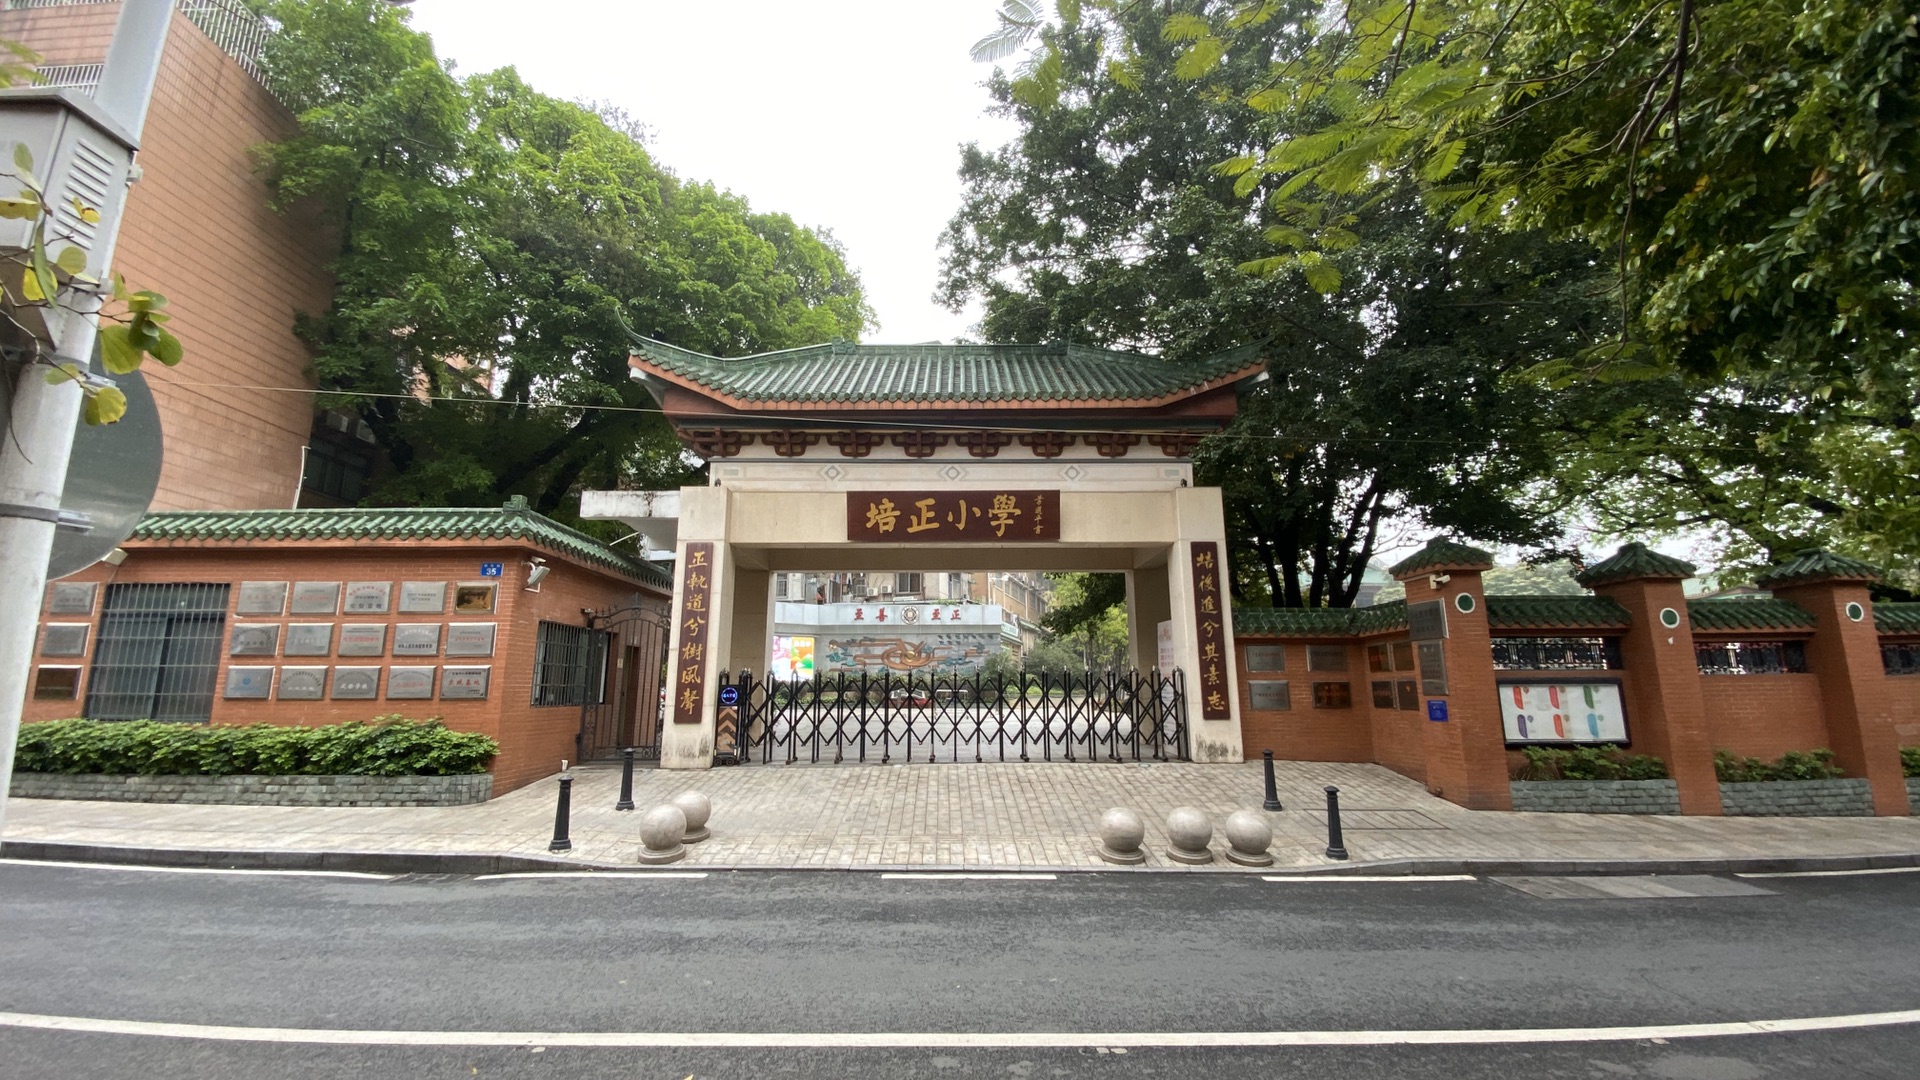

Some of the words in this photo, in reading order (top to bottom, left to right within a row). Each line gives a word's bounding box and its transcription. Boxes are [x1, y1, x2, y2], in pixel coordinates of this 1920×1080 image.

[866, 493, 1022, 537] 培正小學
[486, 567, 497, 576] 35
